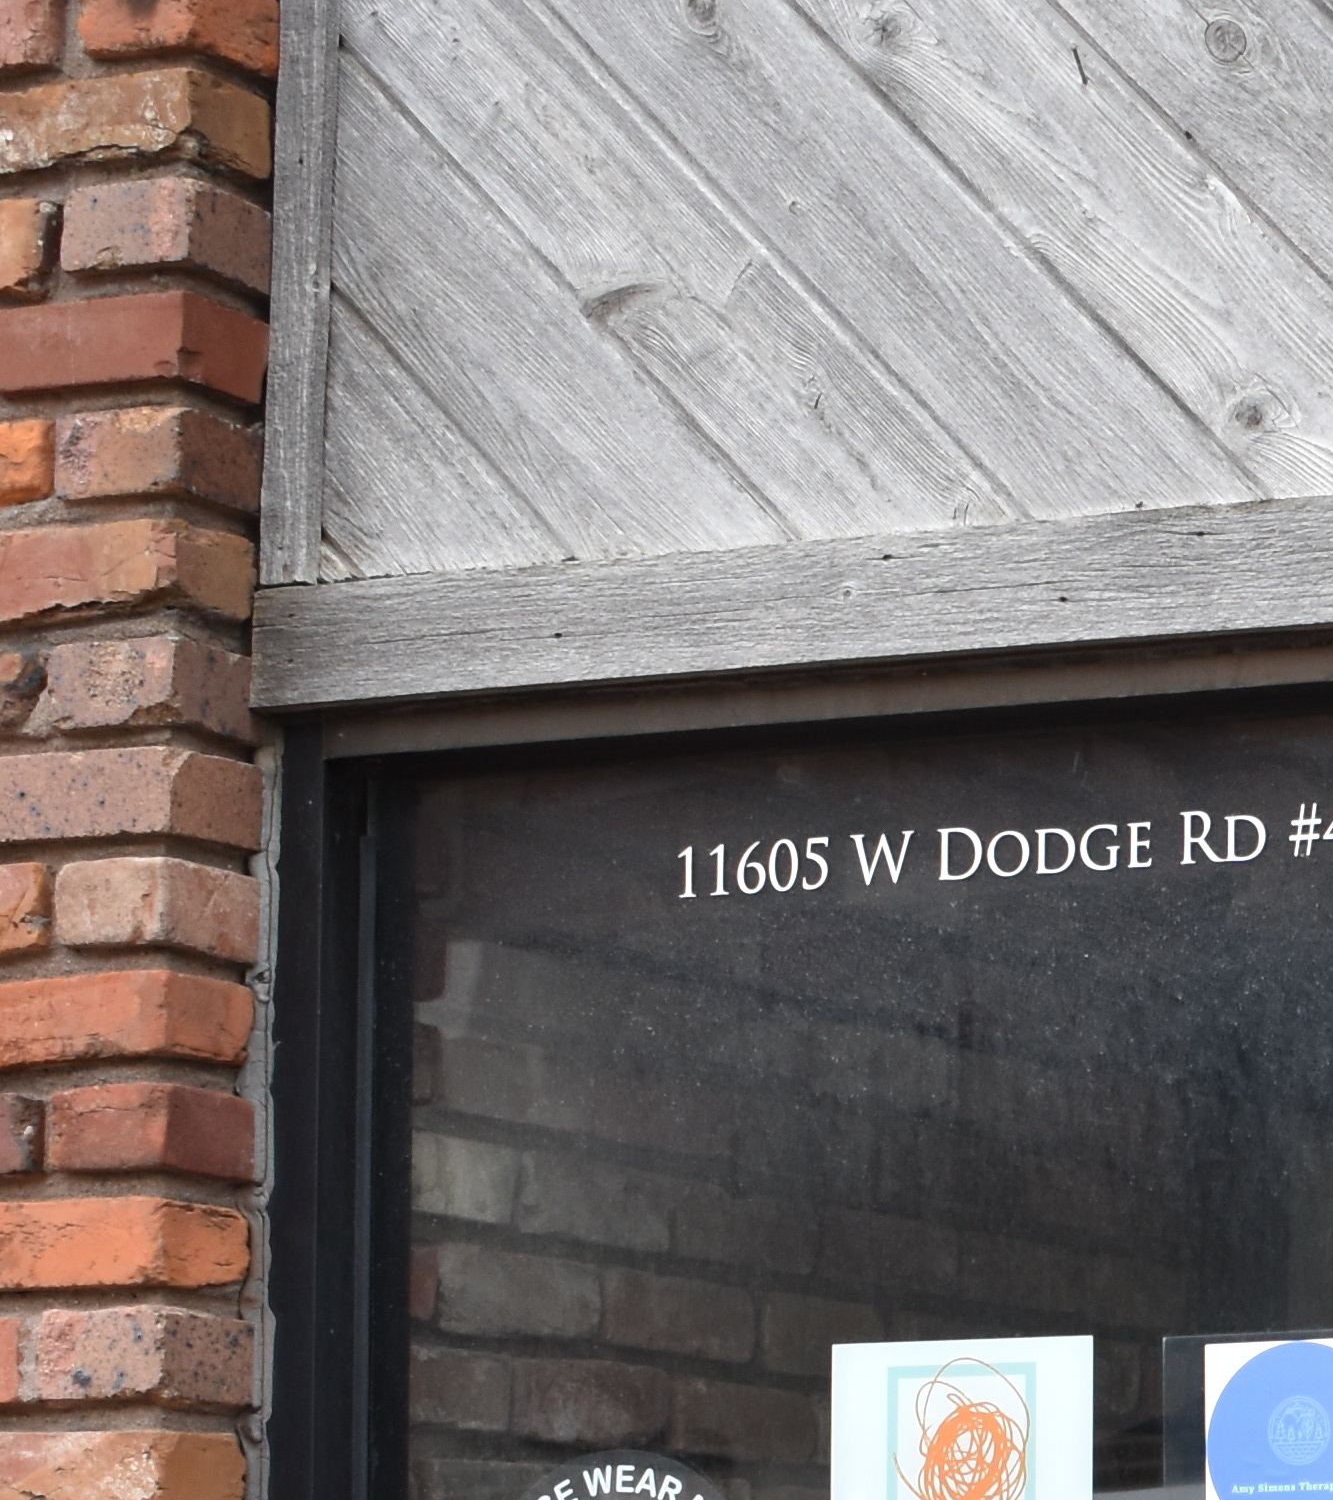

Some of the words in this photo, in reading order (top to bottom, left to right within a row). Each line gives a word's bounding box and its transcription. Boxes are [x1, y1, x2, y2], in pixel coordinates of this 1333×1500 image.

[676, 836, 830, 899] 11605
[849, 830, 915, 886] W
[938, 820, 1153, 882] DODGE
[1180, 809, 1267, 867] RD
[1231, 1484, 1255, 1496] Amy
